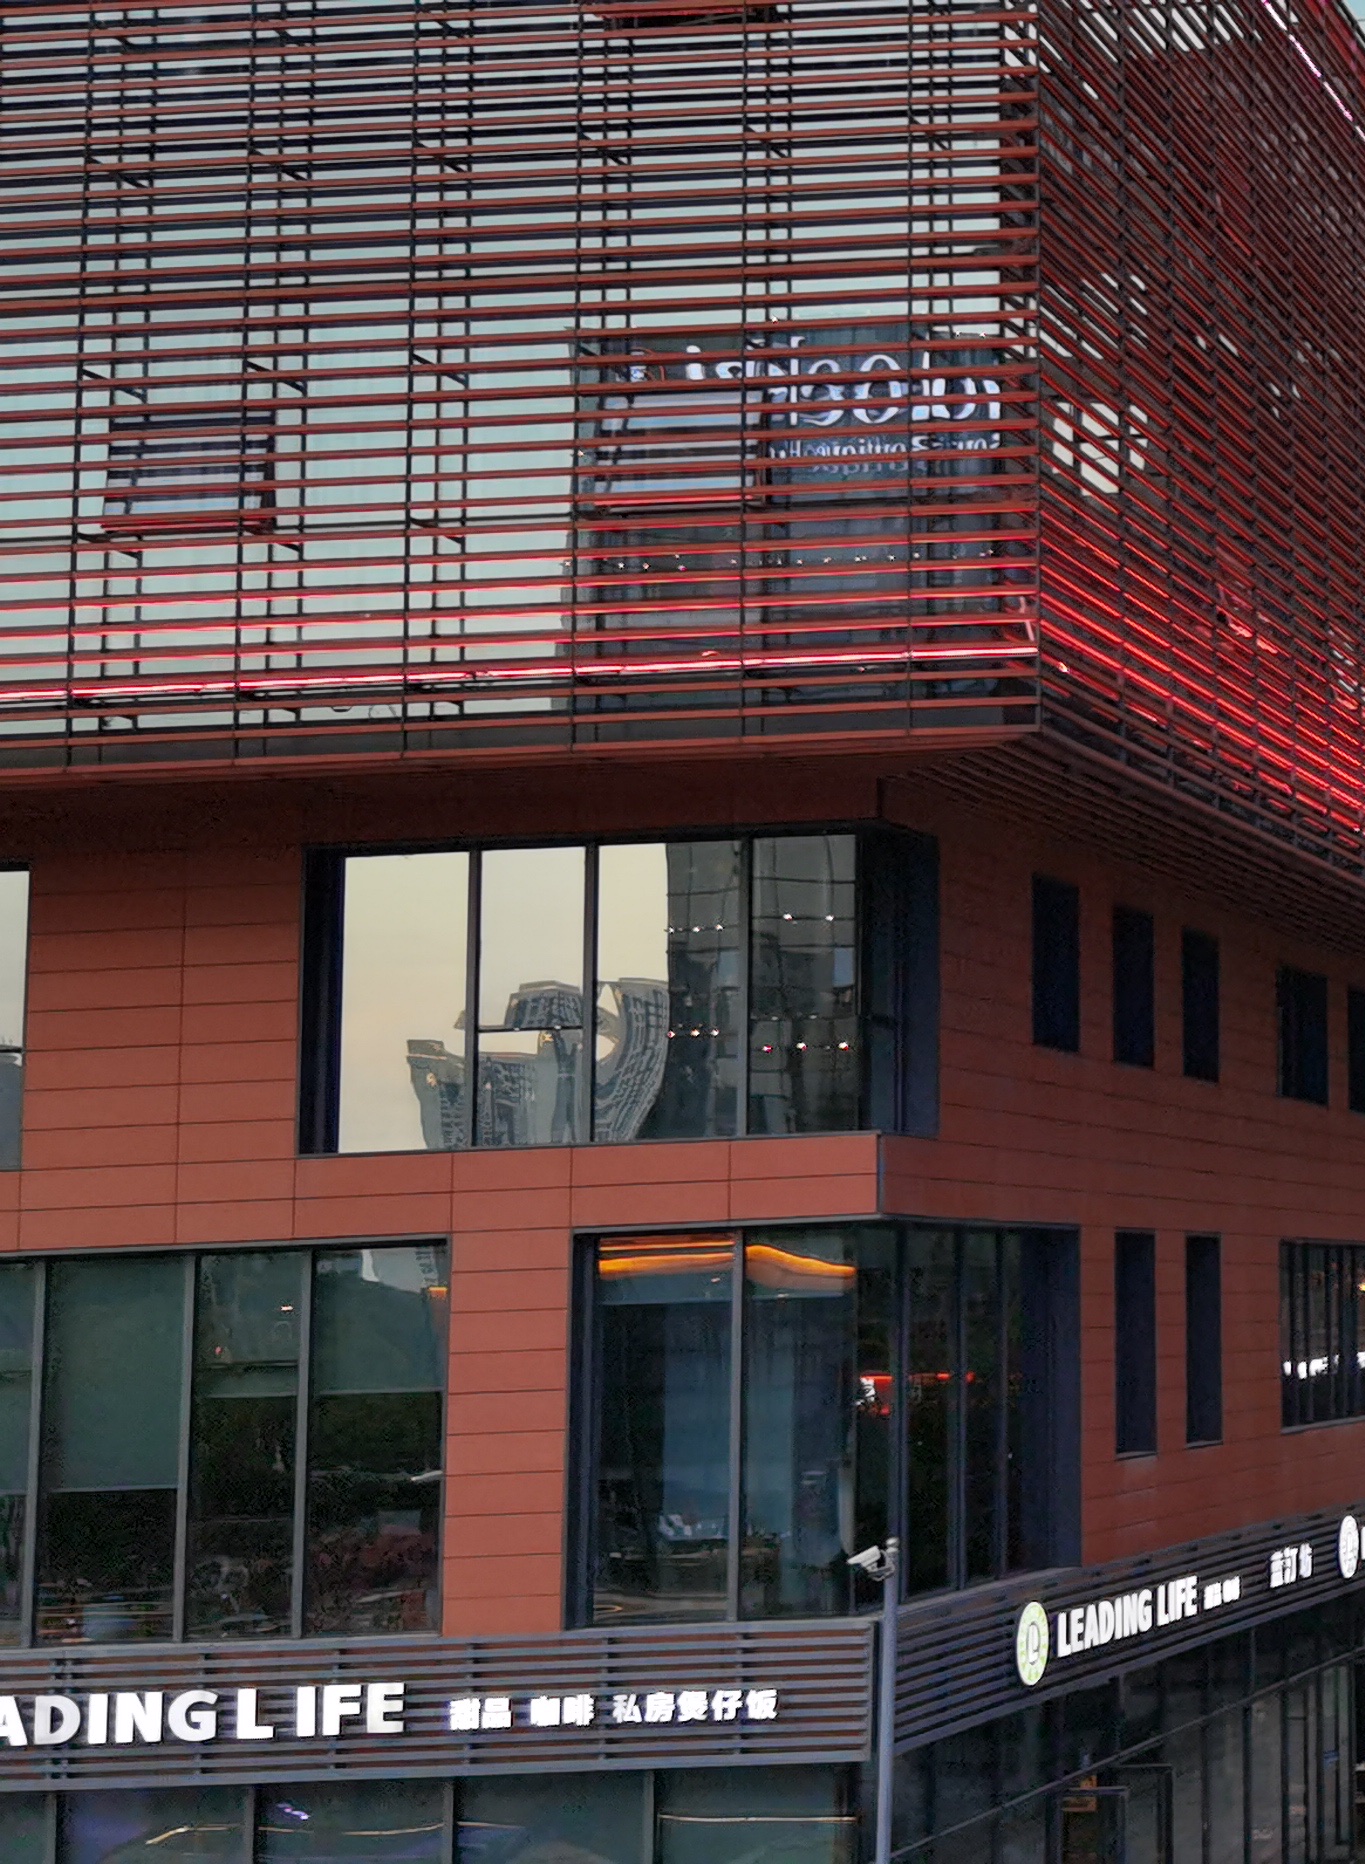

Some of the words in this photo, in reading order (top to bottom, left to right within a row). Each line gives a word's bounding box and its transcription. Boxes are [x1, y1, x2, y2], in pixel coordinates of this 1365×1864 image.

[1057, 1588, 1153, 1658] LEADING
[1157, 1575, 1198, 1626] LIFE
[529, 1693, 595, 1727] 咖啡
[612, 1689, 778, 1724] 私房煲仔饭
